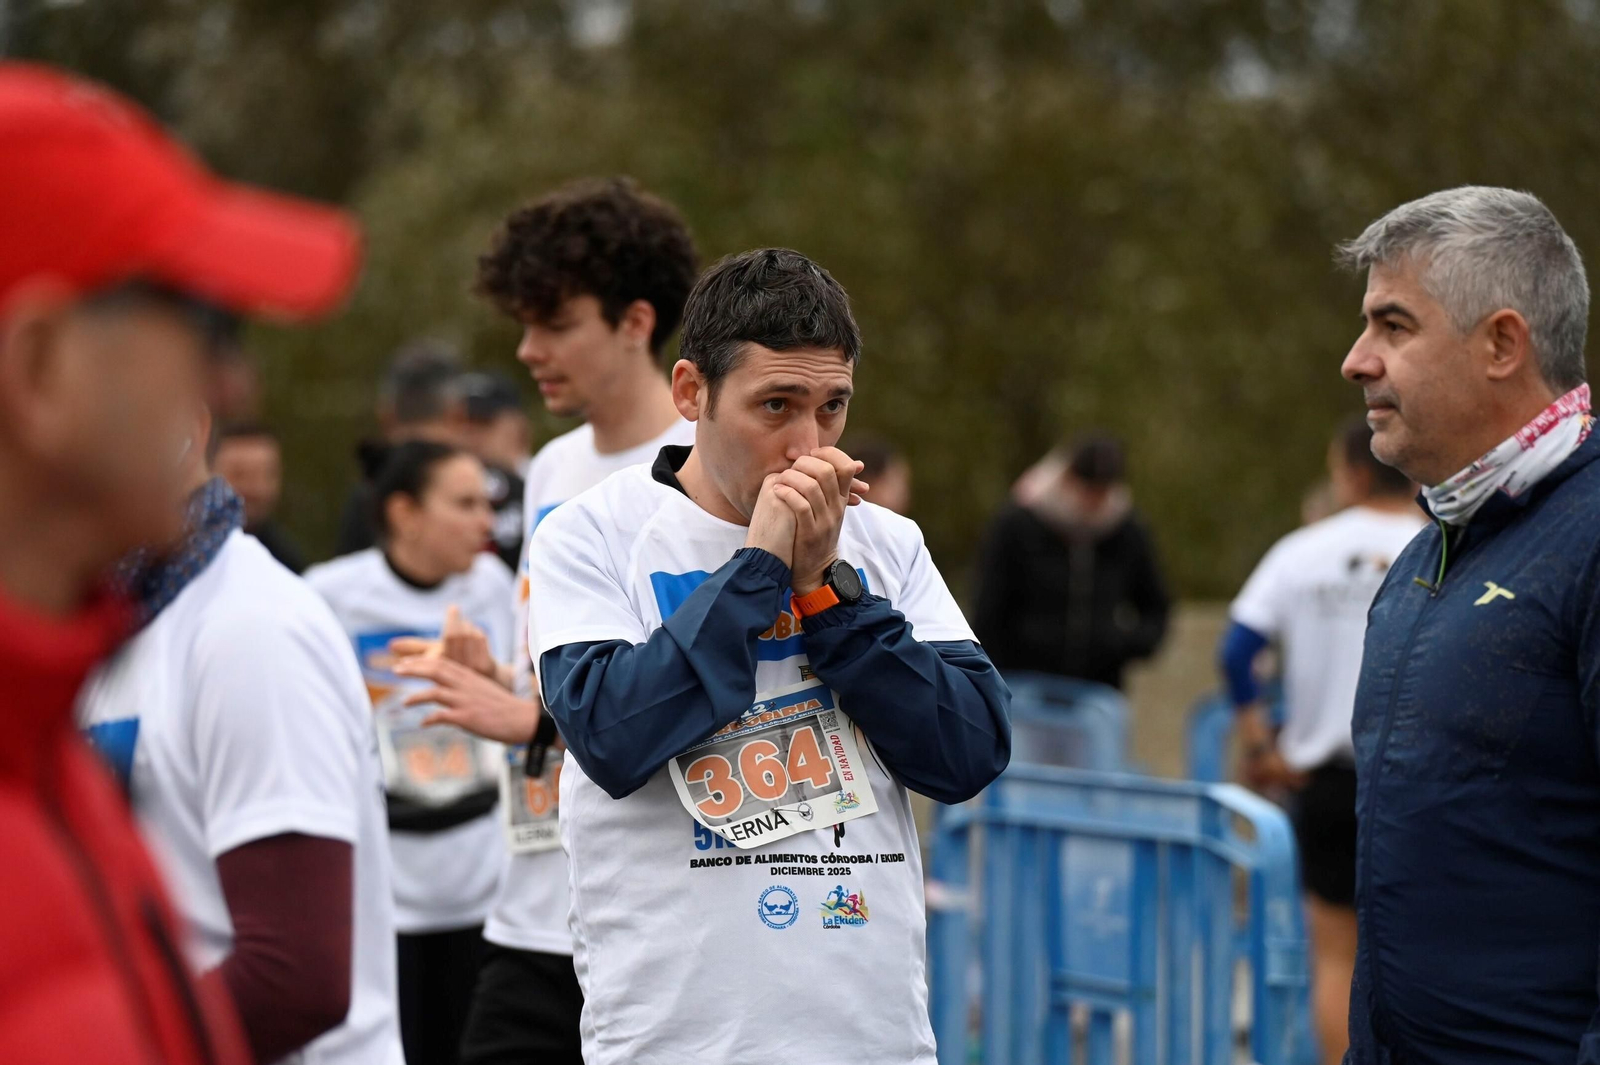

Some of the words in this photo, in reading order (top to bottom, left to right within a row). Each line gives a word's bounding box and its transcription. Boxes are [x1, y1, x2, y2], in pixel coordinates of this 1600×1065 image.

[829, 734, 851, 770] NAVIDAD
[685, 726, 834, 818] 364
[842, 770, 854, 781] EN
[690, 855, 733, 869] BANCO
[735, 854, 752, 865] DE
[754, 852, 818, 865] ALIMENTOS
[820, 851, 874, 865] CÓRDOBA
[770, 866, 825, 876] DICIEMBRE
[827, 866, 852, 876] 2025
[822, 916, 833, 925] La
[834, 914, 865, 925] Ekiden
